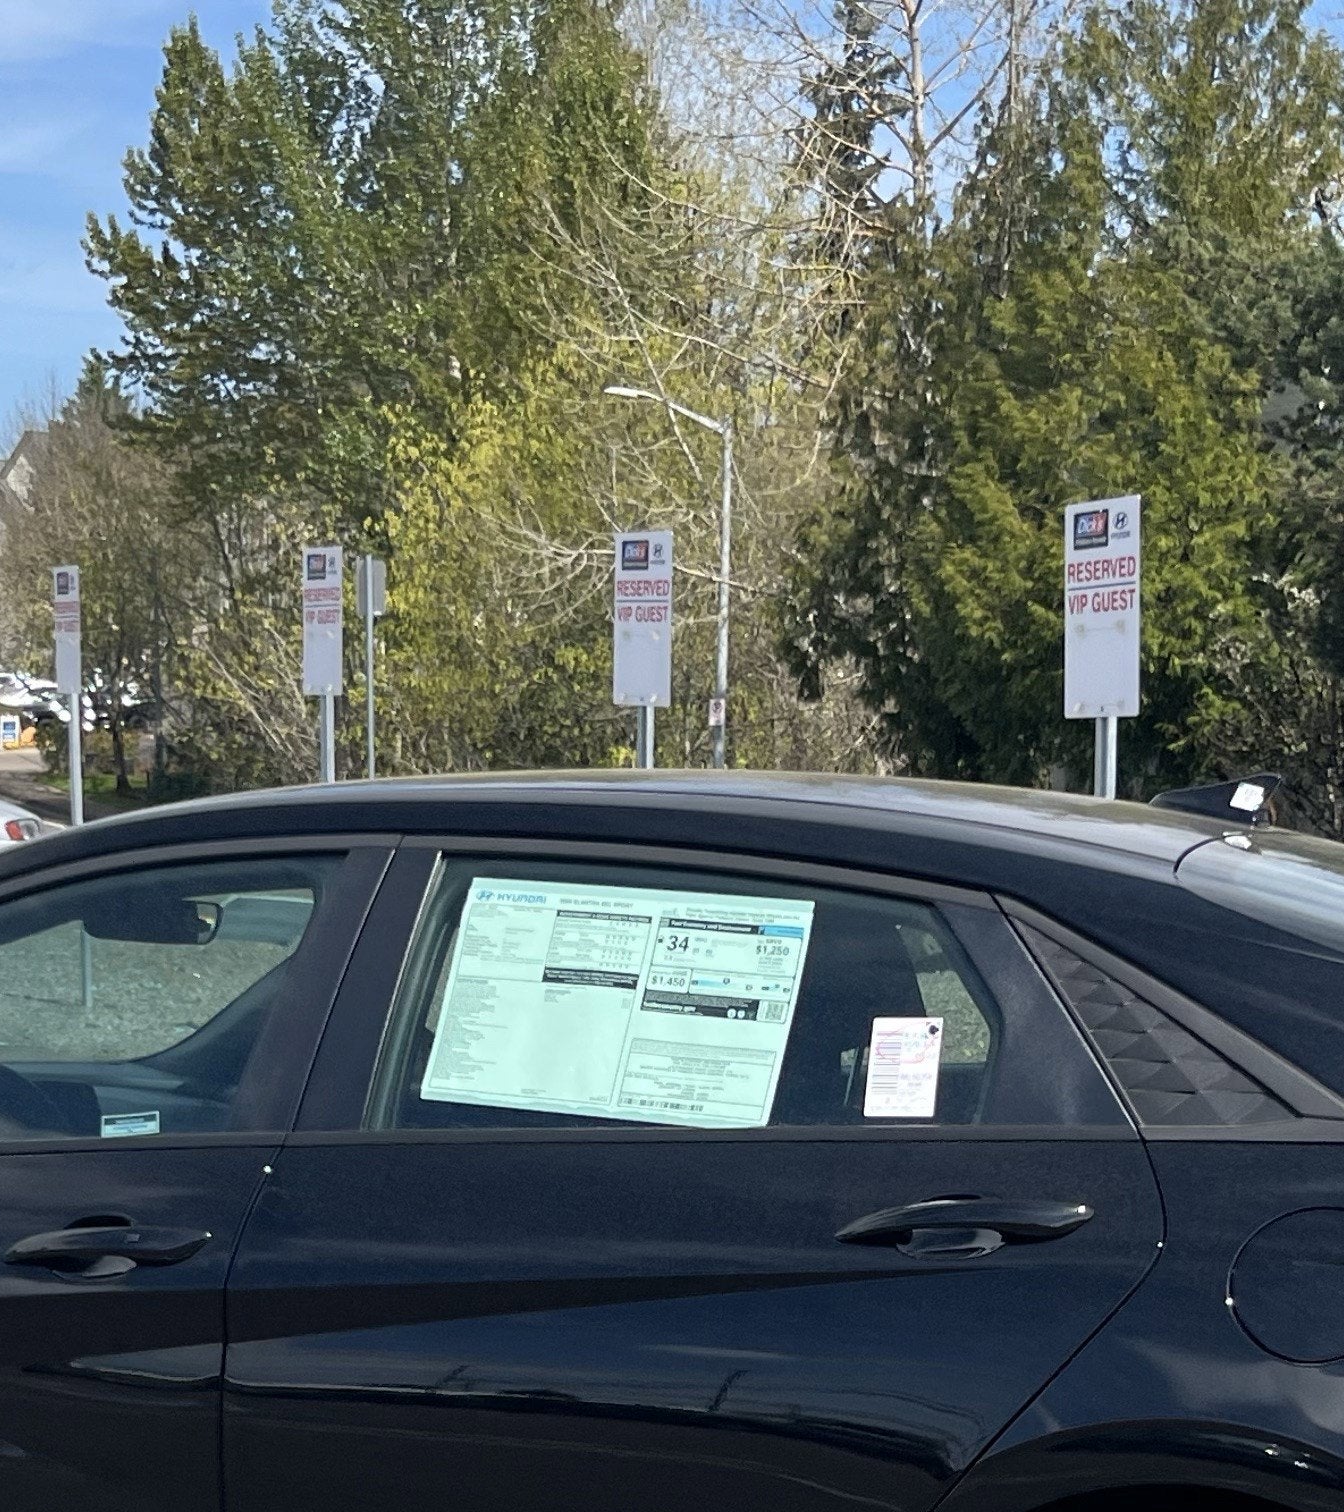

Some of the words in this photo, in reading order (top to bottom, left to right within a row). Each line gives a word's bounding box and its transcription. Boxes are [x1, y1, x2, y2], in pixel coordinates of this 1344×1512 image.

[1067, 555, 1136, 584] RESERVED
[617, 579, 670, 597] RESERVED
[1068, 593, 1088, 616] VIP
[1091, 588, 1136, 614] GUEST
[635, 605, 668, 623] GUEST
[496, 892, 547, 905] HYUNDAI
[666, 935, 690, 952] 34
